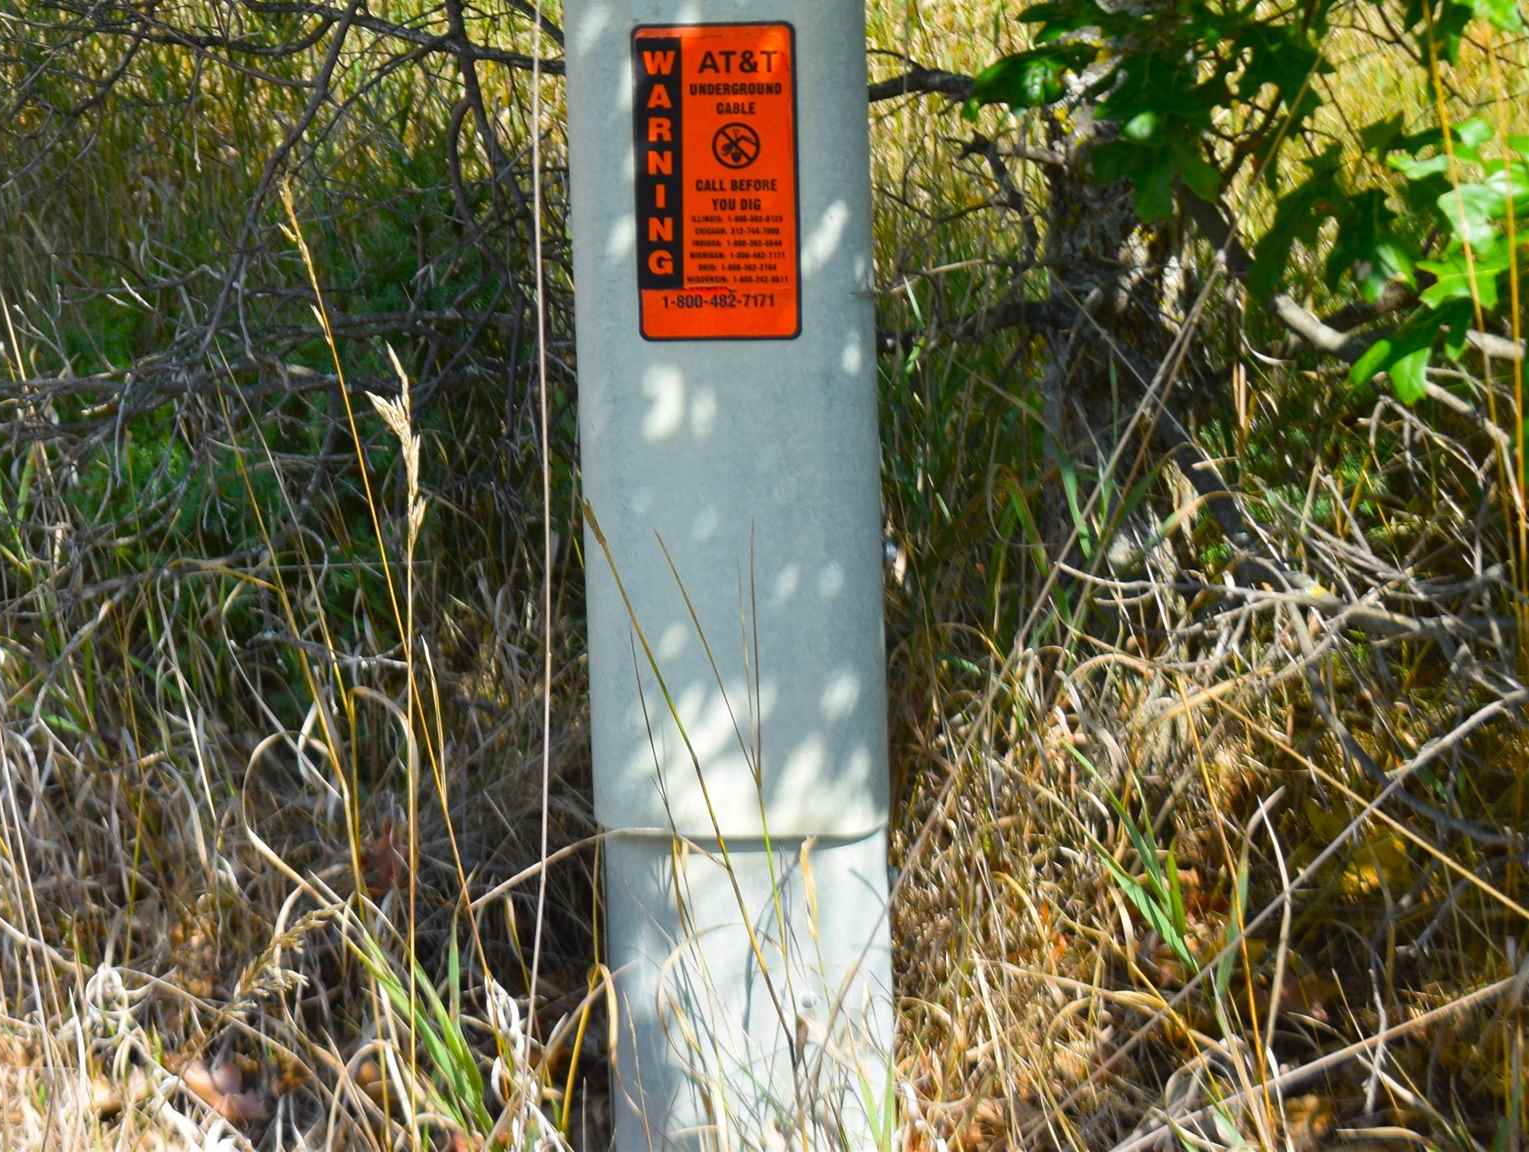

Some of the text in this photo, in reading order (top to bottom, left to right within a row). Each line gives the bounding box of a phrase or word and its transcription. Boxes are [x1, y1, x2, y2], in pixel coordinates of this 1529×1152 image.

[698, 50, 777, 74] AT&T
[689, 82, 783, 96] UNDERGROUND
[716, 101, 757, 116] CABLE
[642, 50, 676, 277] WARNING
[695, 178, 778, 193] CALL BEFORE
[712, 198, 762, 212] YOU DIG
[662, 293, 776, 309] 1-800-482-7171
